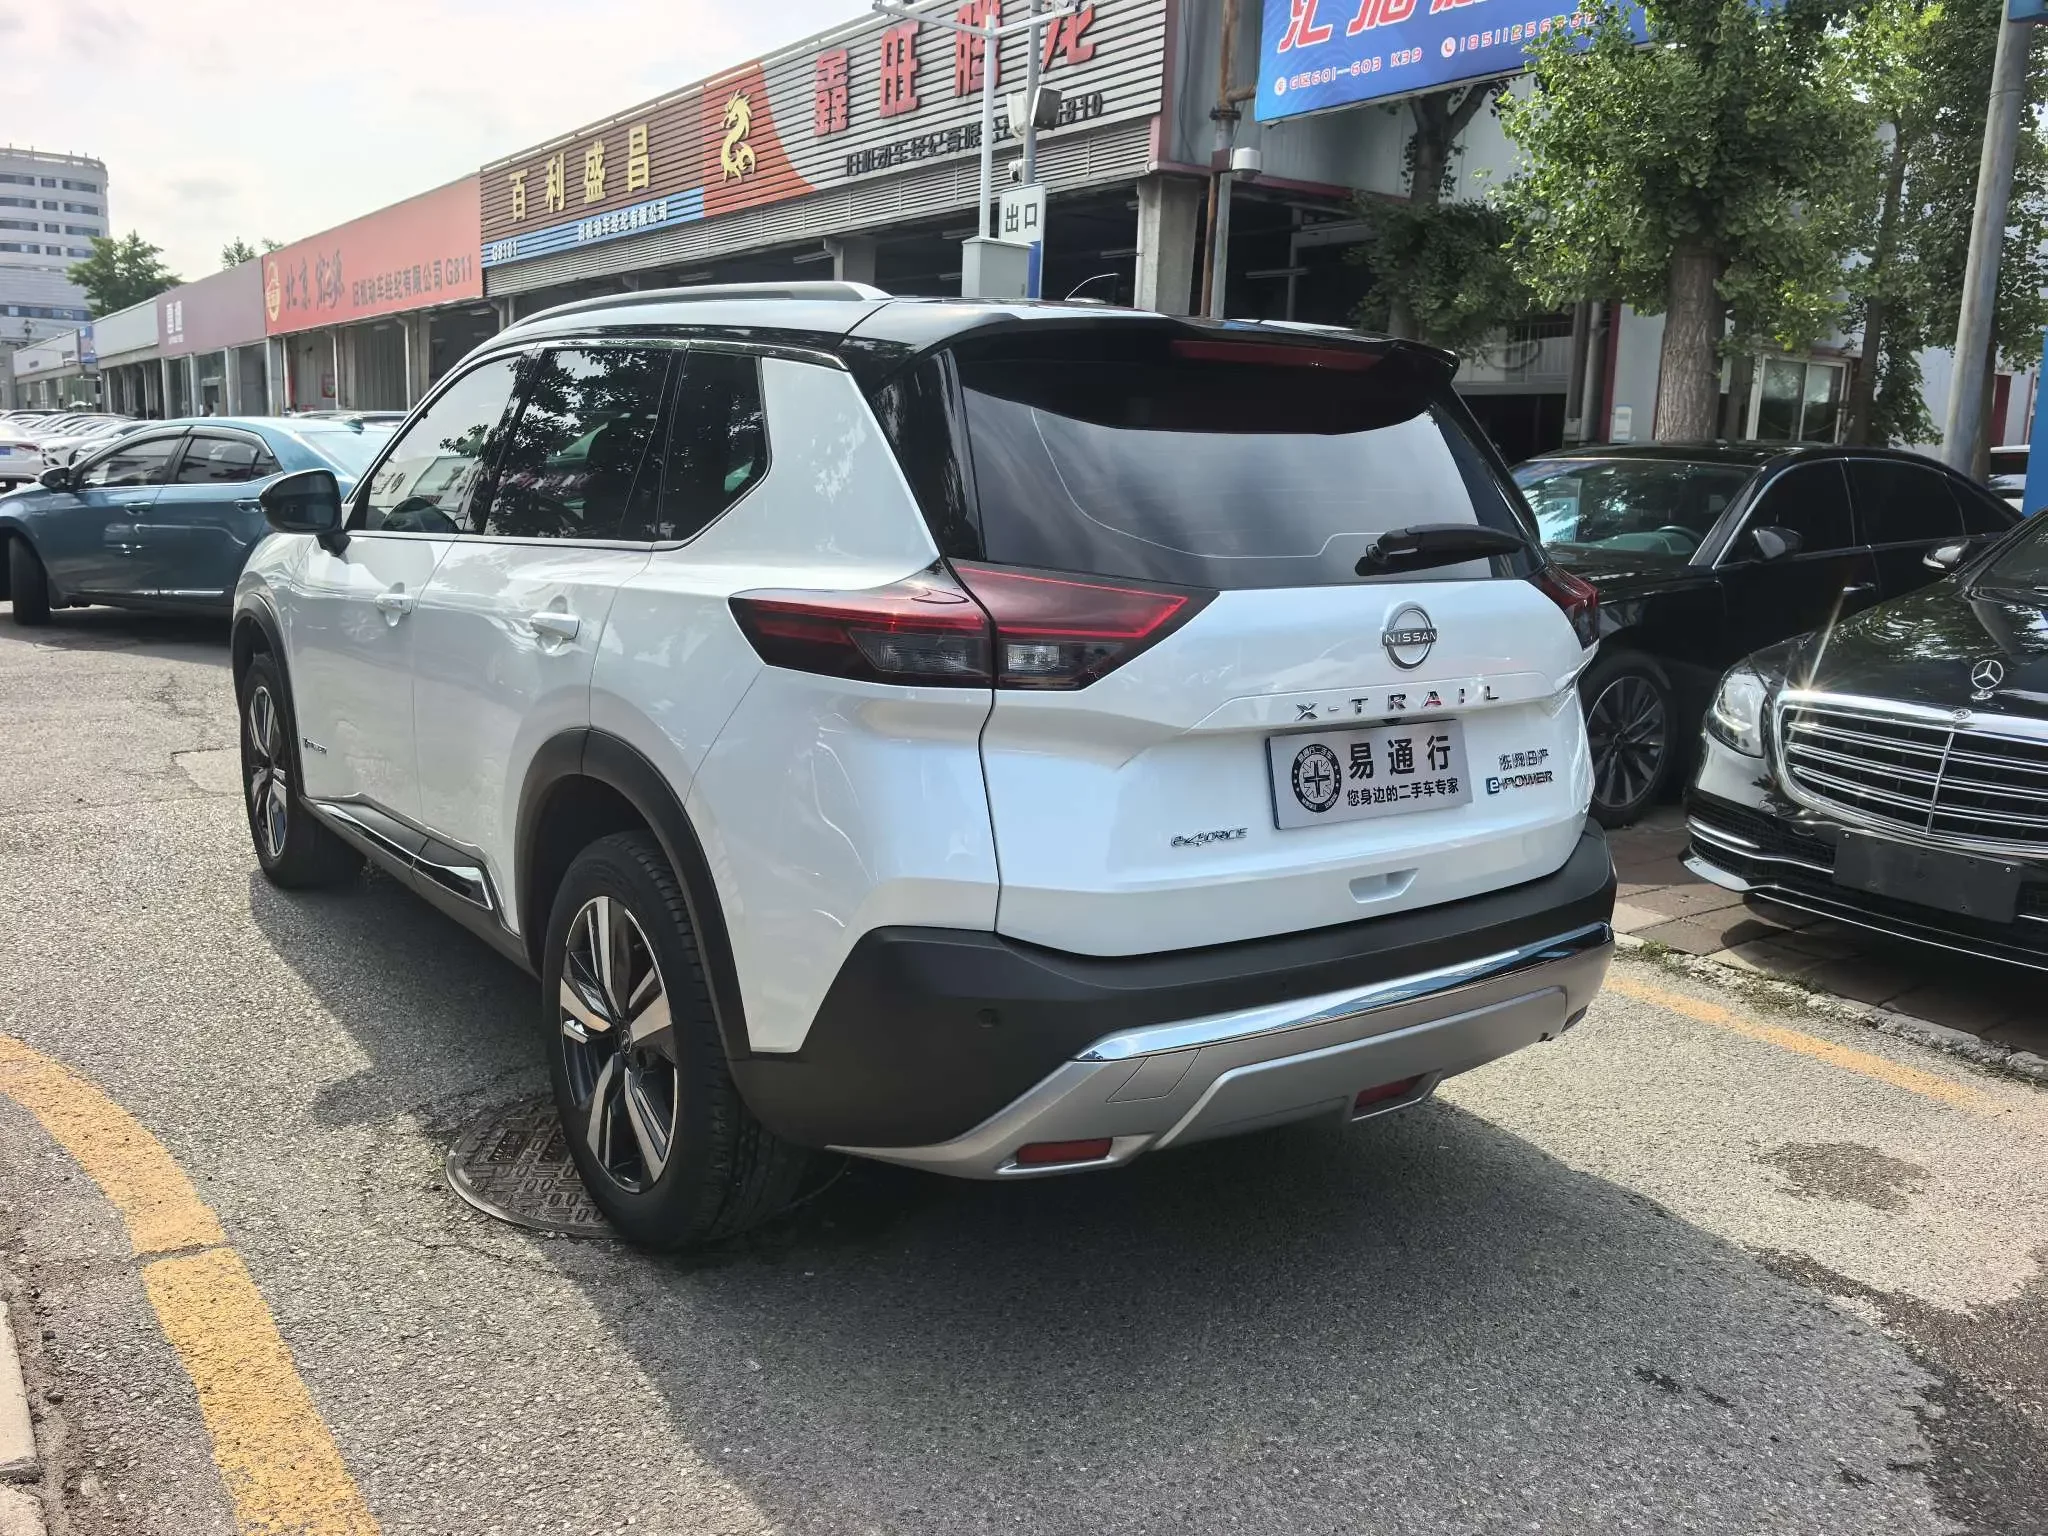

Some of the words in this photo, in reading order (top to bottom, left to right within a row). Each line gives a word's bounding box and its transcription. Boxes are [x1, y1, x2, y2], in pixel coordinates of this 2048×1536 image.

[1390, 47, 1422, 67] K39
[509, 123, 649, 222] 百利盛昌
[1005, 202, 1038, 233] 出口
[446, 254, 472, 285] G811
[1385, 631, 1437, 644] NISSAN
[1295, 685, 1500, 721] X-TRAIL
[1349, 735, 1451, 780] 易通行
[1346, 777, 1459, 807] 您身边的二手车专家
